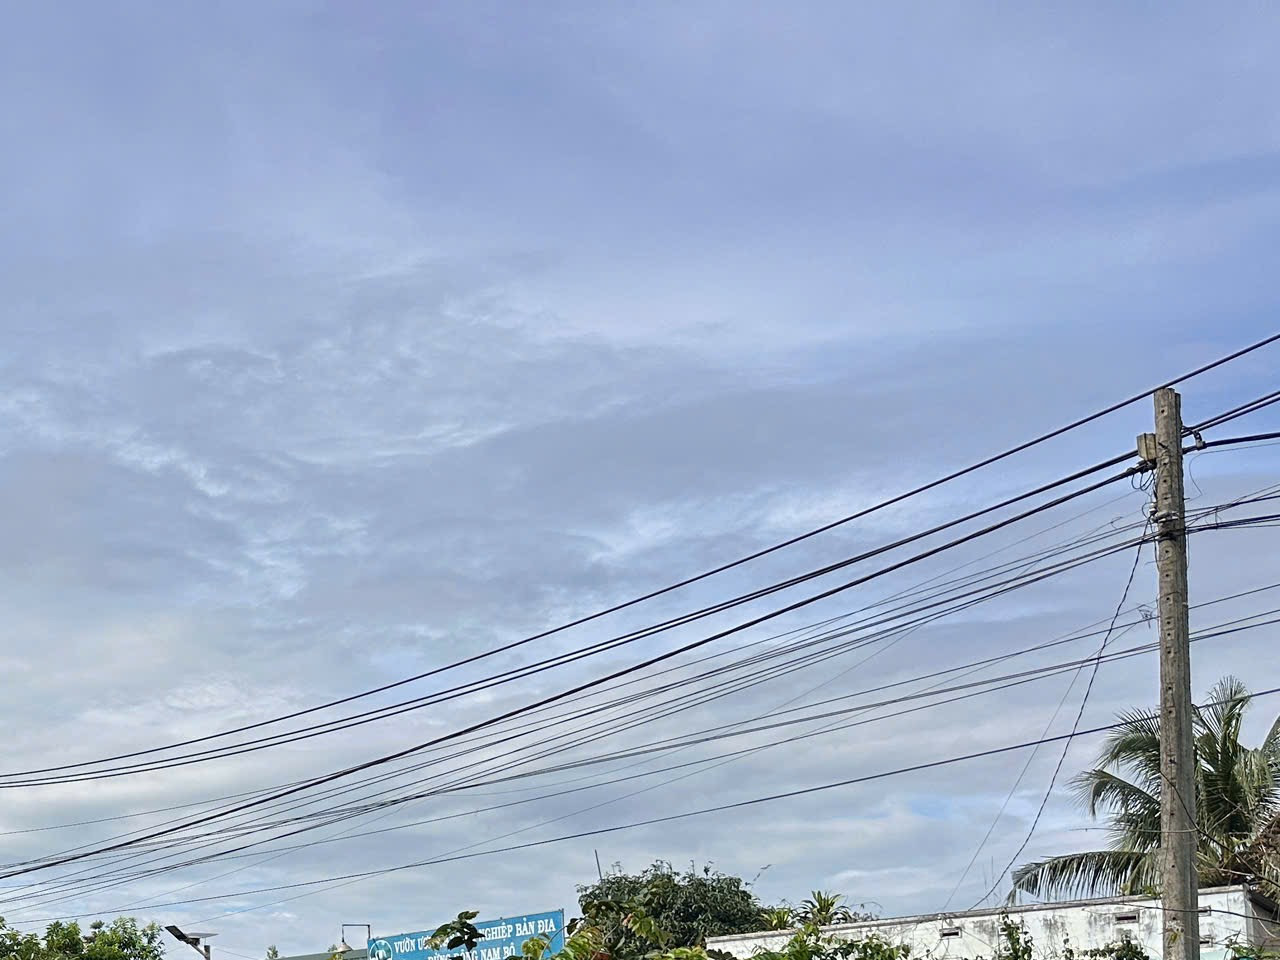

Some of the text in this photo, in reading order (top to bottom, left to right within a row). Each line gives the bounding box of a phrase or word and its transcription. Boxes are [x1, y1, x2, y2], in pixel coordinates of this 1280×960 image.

[393, 936, 417, 954] VƯỜN
[478, 921, 513, 943] NGHIỆP
[515, 916, 535, 937] BẢN
